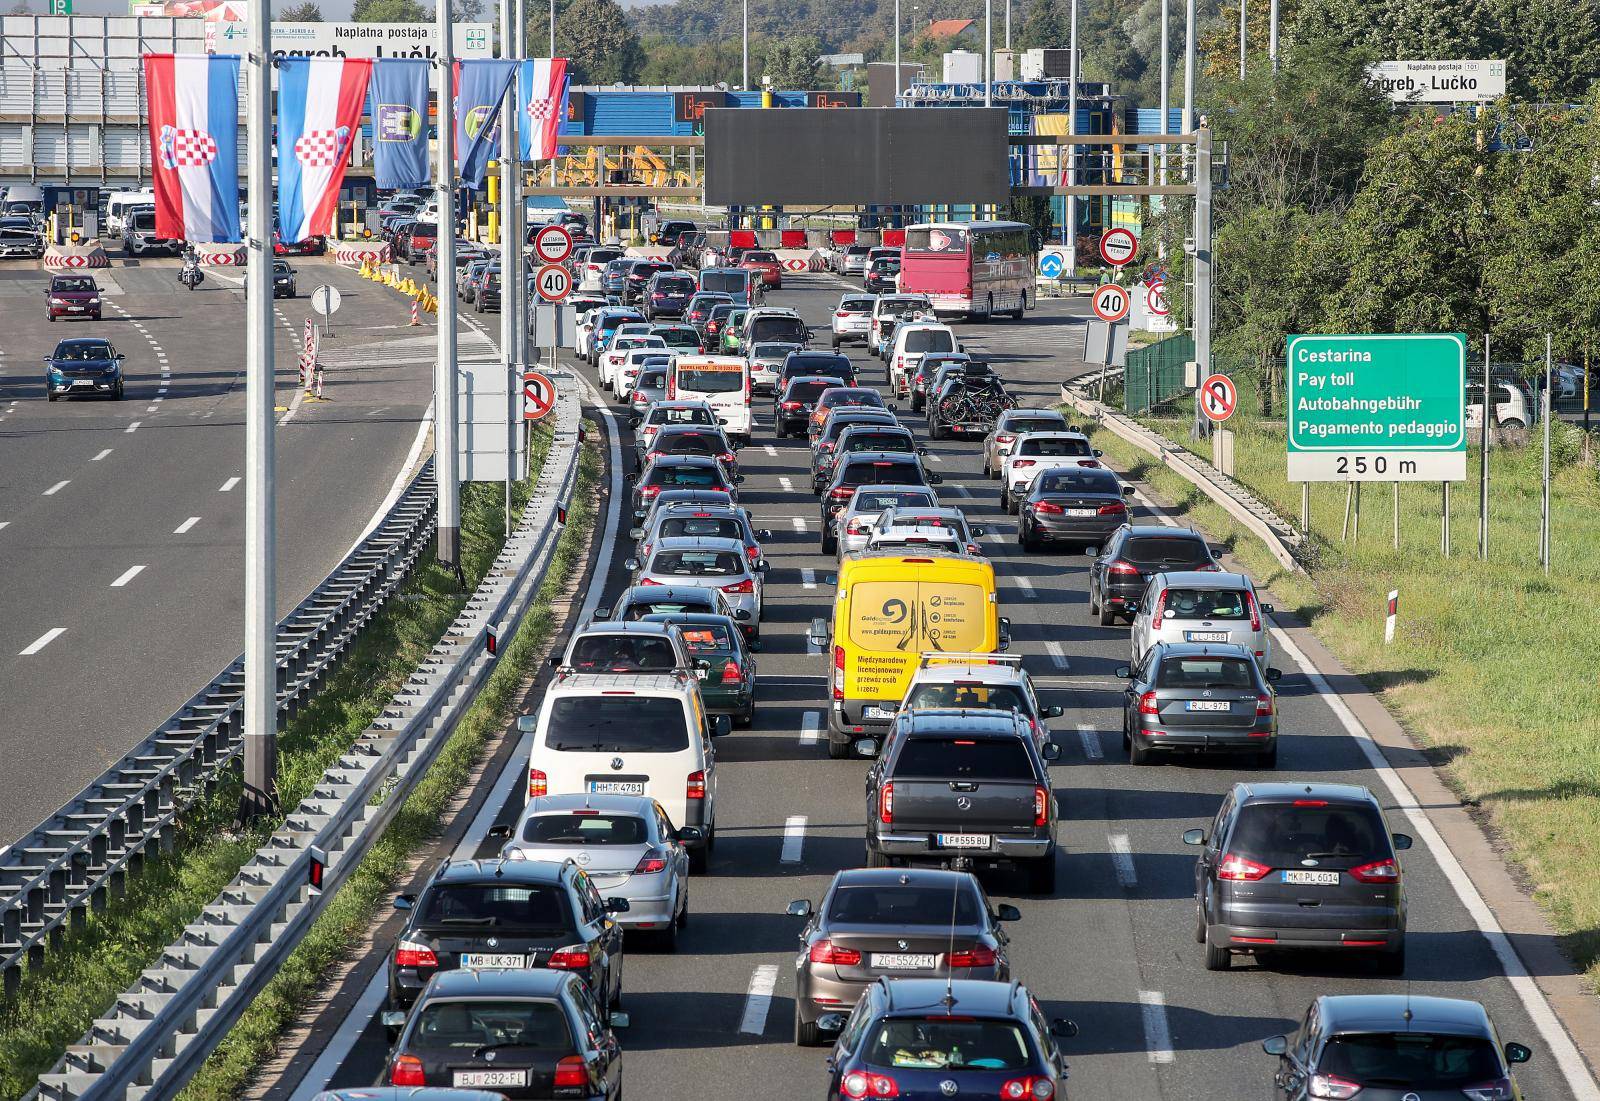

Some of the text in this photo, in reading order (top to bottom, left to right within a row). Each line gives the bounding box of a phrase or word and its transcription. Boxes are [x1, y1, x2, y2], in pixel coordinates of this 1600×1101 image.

[335, 27, 383, 39] Naplatna
[388, 26, 428, 39] postaja
[1407, 63, 1437, 71] Naplatna
[1438, 63, 1462, 71] postaja
[1431, 74, 1478, 91] Lučko
[544, 274, 564, 291] 40
[1100, 294, 1121, 312] 40
[1298, 348, 1372, 363] Cestarina
[1298, 372, 1354, 389] Pay toll
[1298, 396, 1422, 414] Autobahngebühr
[1298, 420, 1457, 438] Pagamento pedaggio
[1336, 456, 1417, 474] 250 m
[857, 666, 904, 676] licencjonowany
